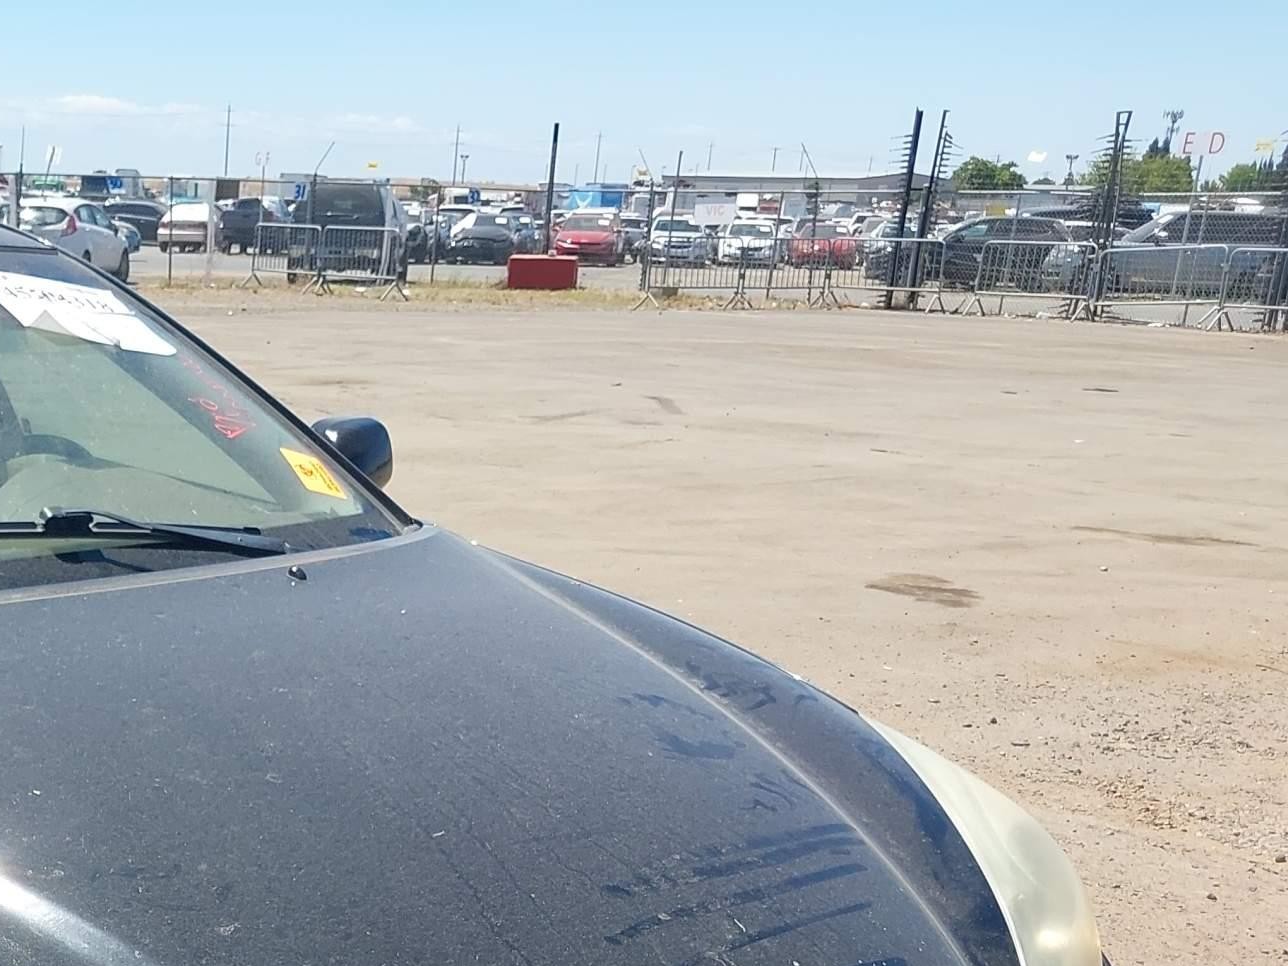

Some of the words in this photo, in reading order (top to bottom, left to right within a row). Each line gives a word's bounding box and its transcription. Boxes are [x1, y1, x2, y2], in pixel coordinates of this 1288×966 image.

[1182, 131, 1197, 155] E
[1208, 131, 1226, 155] D
[295, 184, 306, 200] 31
